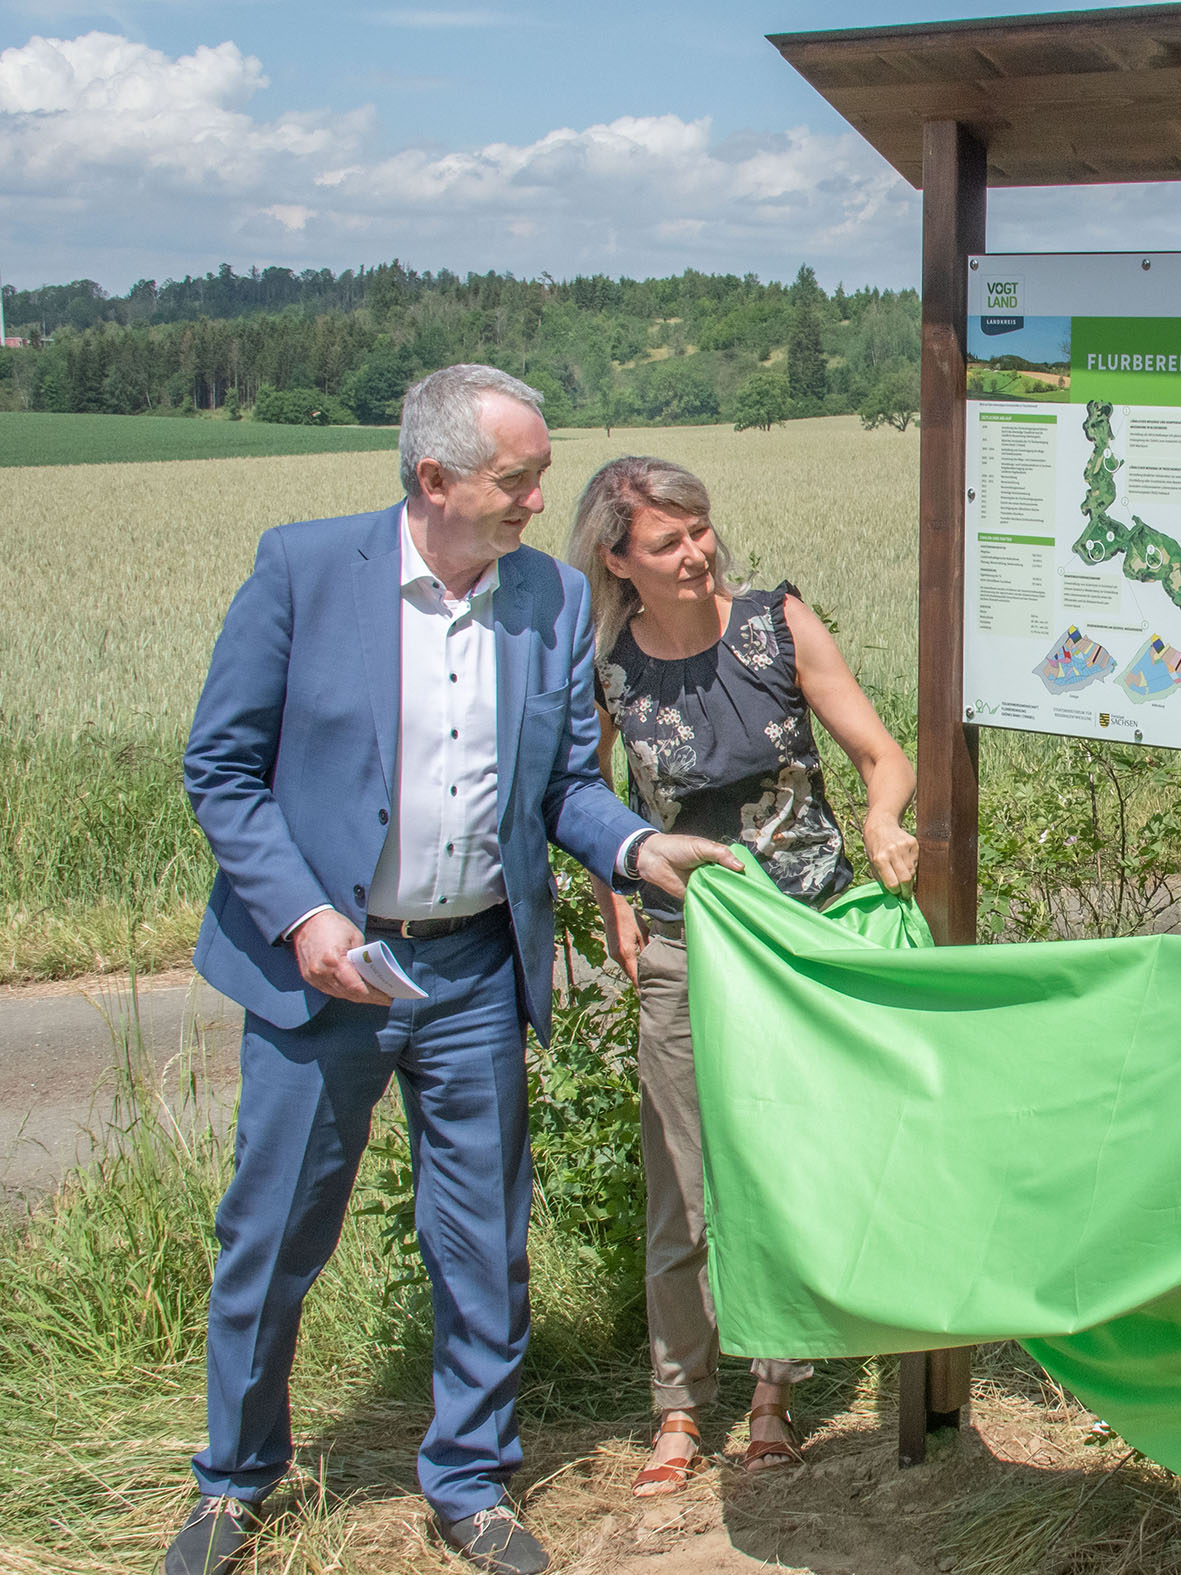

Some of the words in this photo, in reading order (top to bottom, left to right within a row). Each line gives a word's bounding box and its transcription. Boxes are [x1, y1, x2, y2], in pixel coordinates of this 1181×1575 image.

[986, 281, 1019, 295] VOGT
[987, 295, 1018, 309] LAND
[1110, 718, 1138, 727] SACHSEN
